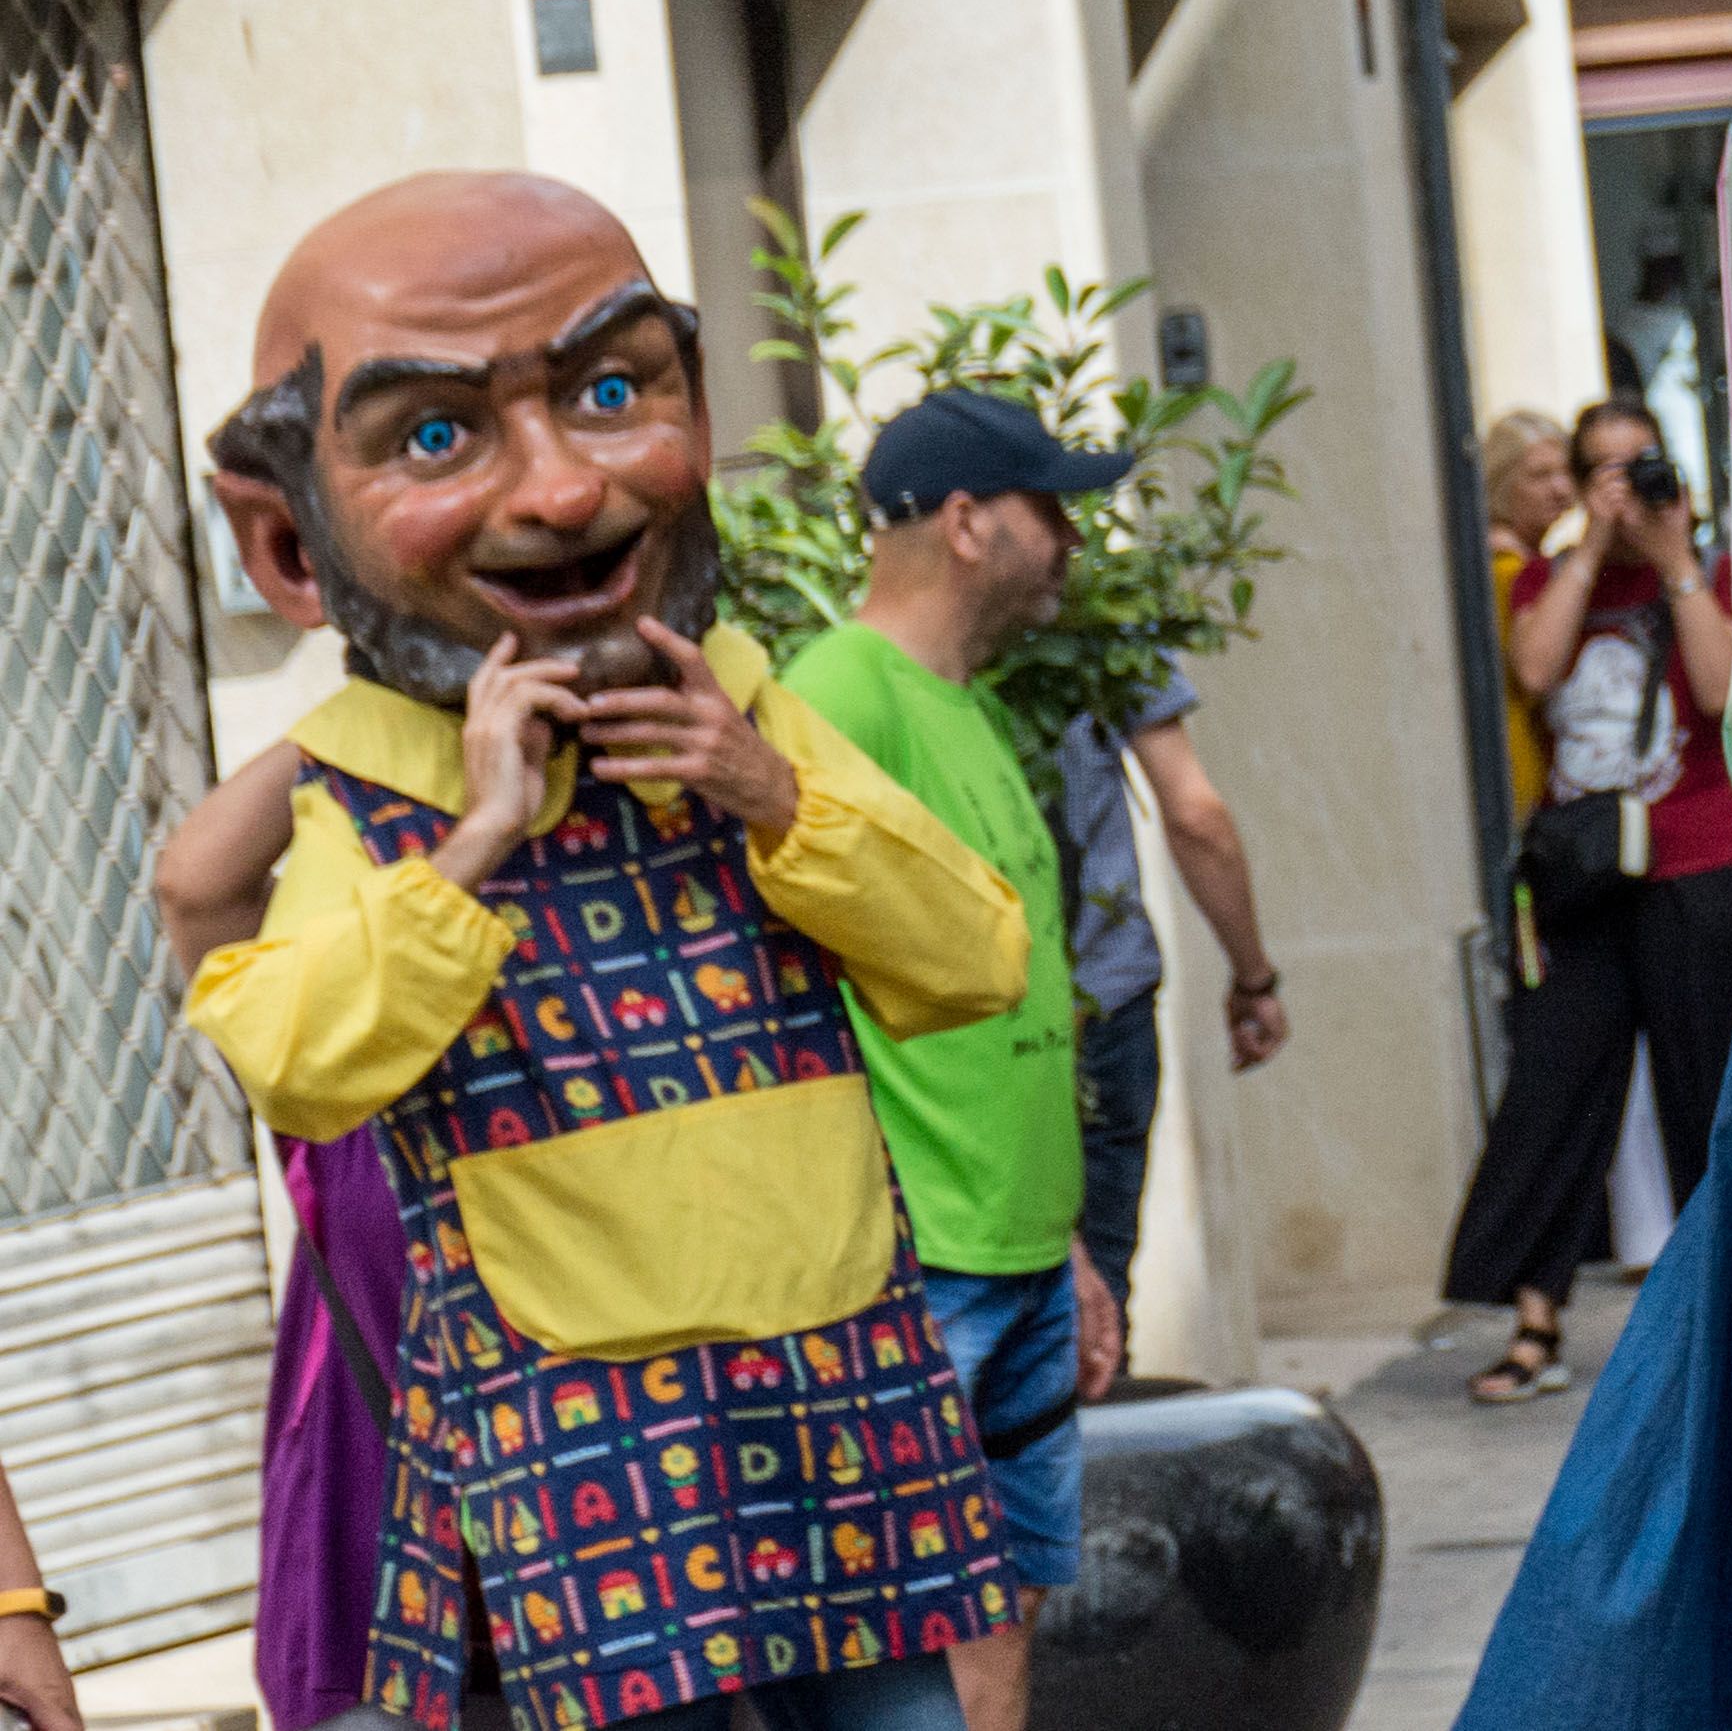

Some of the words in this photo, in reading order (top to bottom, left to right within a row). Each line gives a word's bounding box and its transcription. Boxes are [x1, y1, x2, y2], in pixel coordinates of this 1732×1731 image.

[580, 900, 624, 942] D
[536, 995, 576, 1041] C
[488, 1108, 532, 1148] A
[643, 1357, 684, 1402] C
[737, 1443, 778, 1482] D
[890, 1421, 924, 1464] A
[573, 1482, 618, 1527] A
[686, 1544, 726, 1591] C
[921, 1611, 959, 1652] A
[765, 1634, 796, 1674] D
[619, 1669, 664, 1716] A
